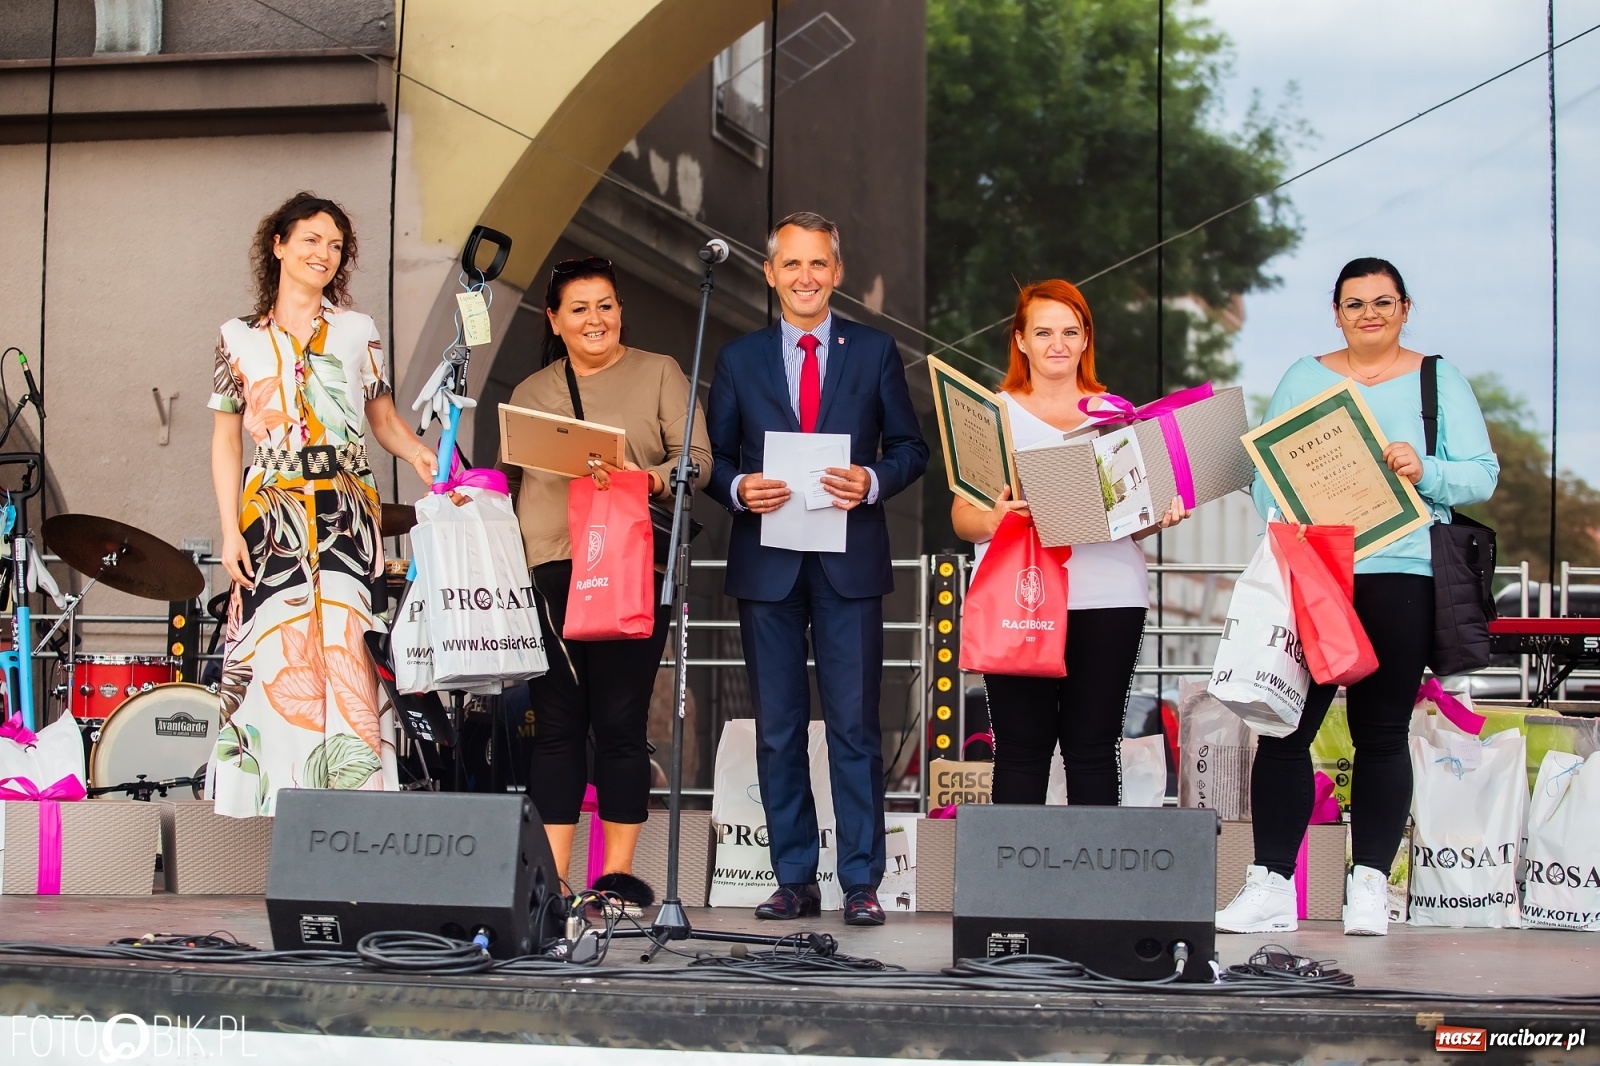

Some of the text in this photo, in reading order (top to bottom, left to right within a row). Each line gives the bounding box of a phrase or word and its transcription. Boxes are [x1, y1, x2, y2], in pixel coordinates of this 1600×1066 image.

[955, 398, 991, 426] DYPLOM
[1289, 425, 1343, 459] DYPLOM
[1002, 617, 1055, 631] RACIBÓRZ
[157, 720, 207, 733] AvantGarde
[308, 829, 478, 857] POL-AUDIO
[997, 846, 1176, 872] POL-AUDIO
